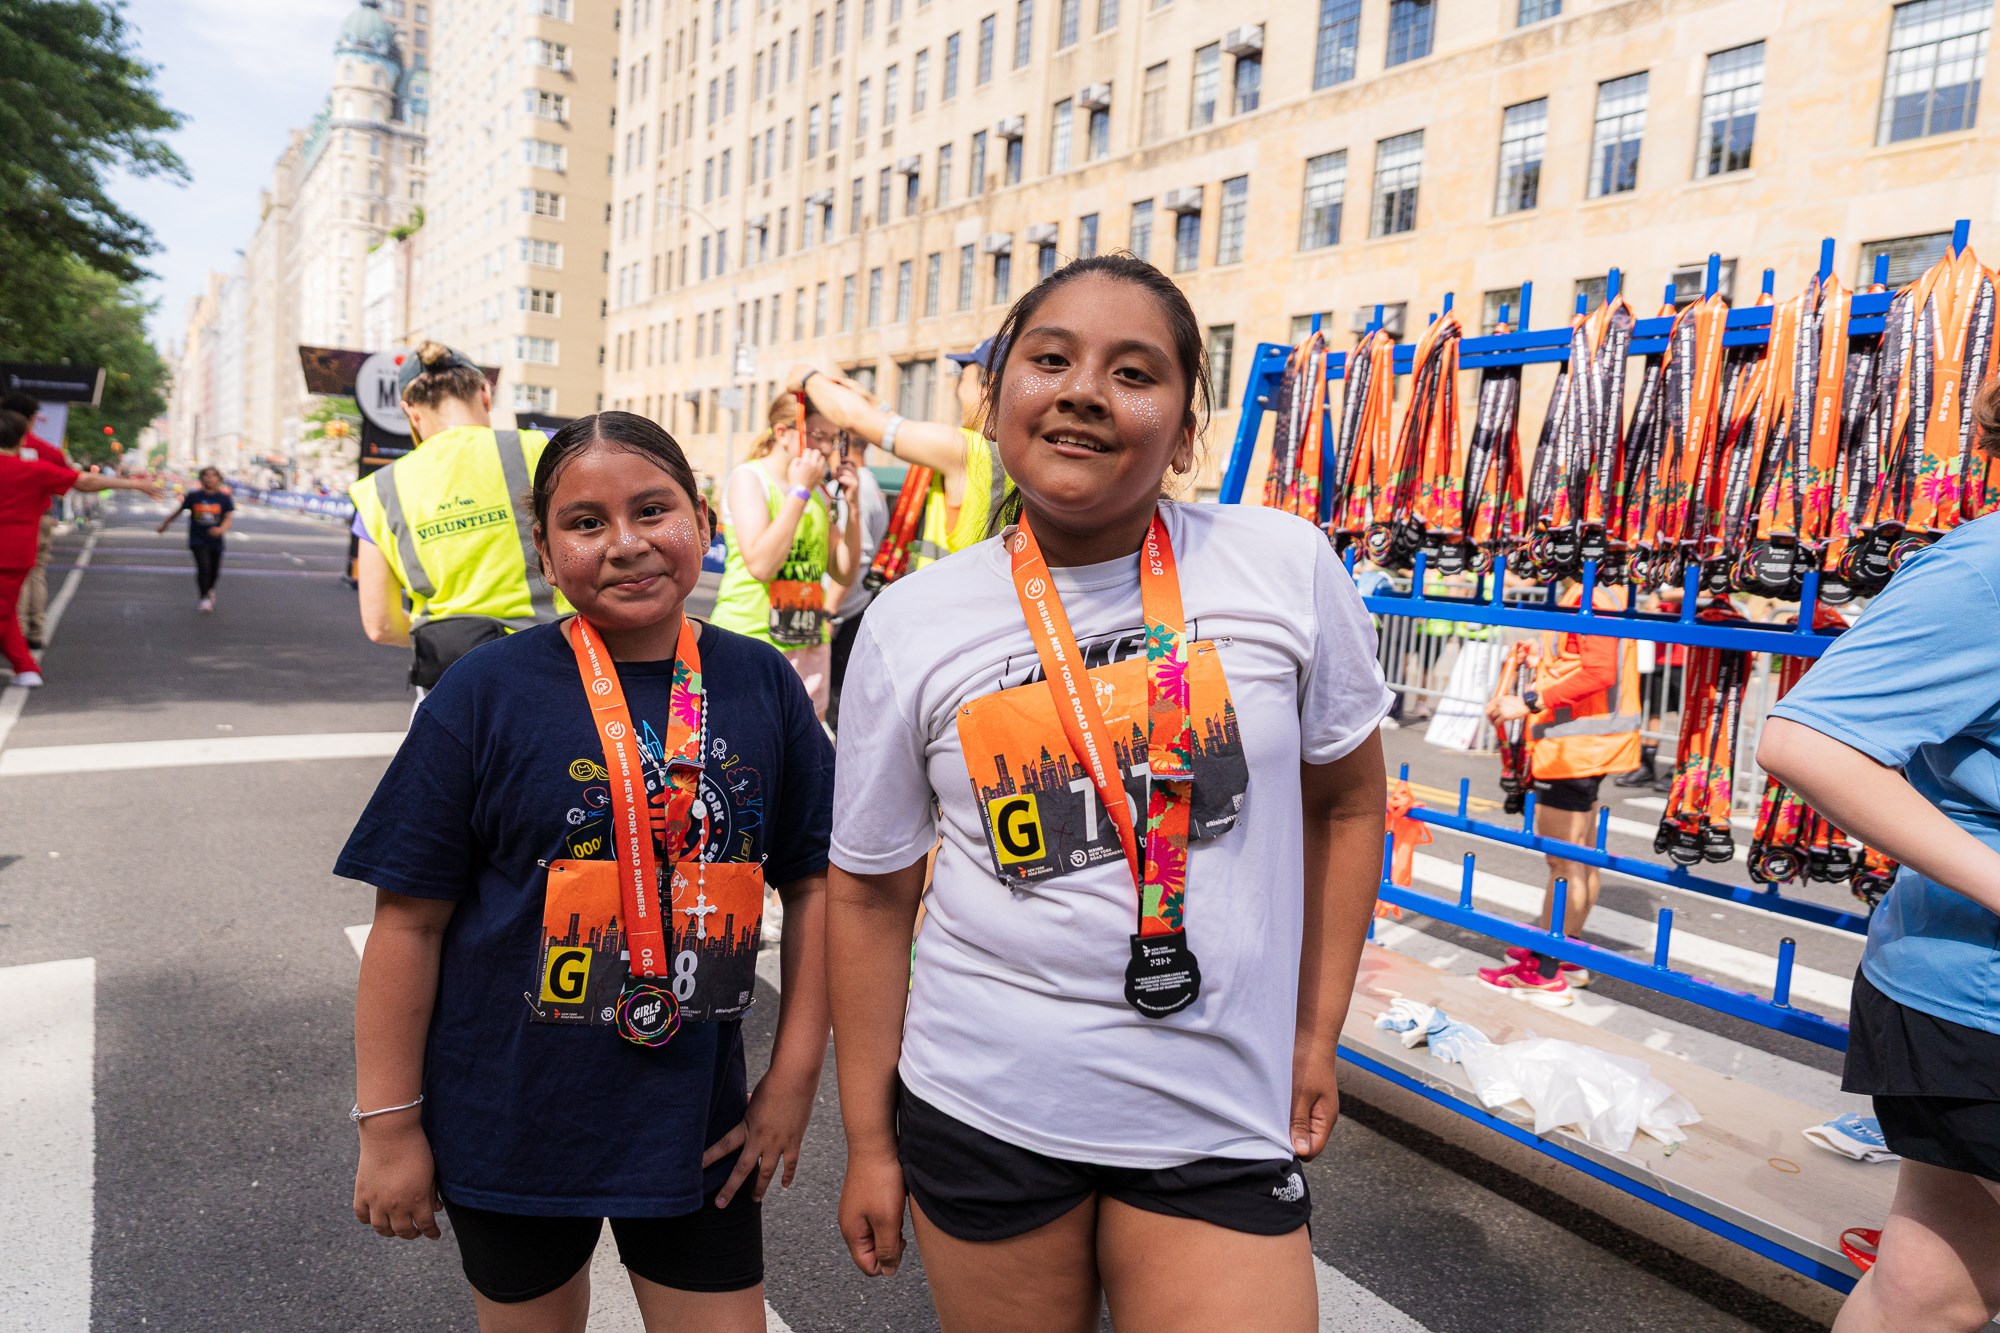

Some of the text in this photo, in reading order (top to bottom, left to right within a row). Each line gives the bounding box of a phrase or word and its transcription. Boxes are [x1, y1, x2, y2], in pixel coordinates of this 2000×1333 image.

[417, 509, 508, 540] VOLUNTEER
[588, 647, 603, 677] RISING
[1036, 599, 1108, 789] RISING NEW YORK ROAD RUNNERS
[615, 741, 647, 919] RISING NEW YORK ROAD RUNNERS
[998, 799, 1041, 858] G
[550, 950, 587, 1001] G
[633, 1000, 662, 1021] GIRLS
[642, 1013, 657, 1027] RUN
